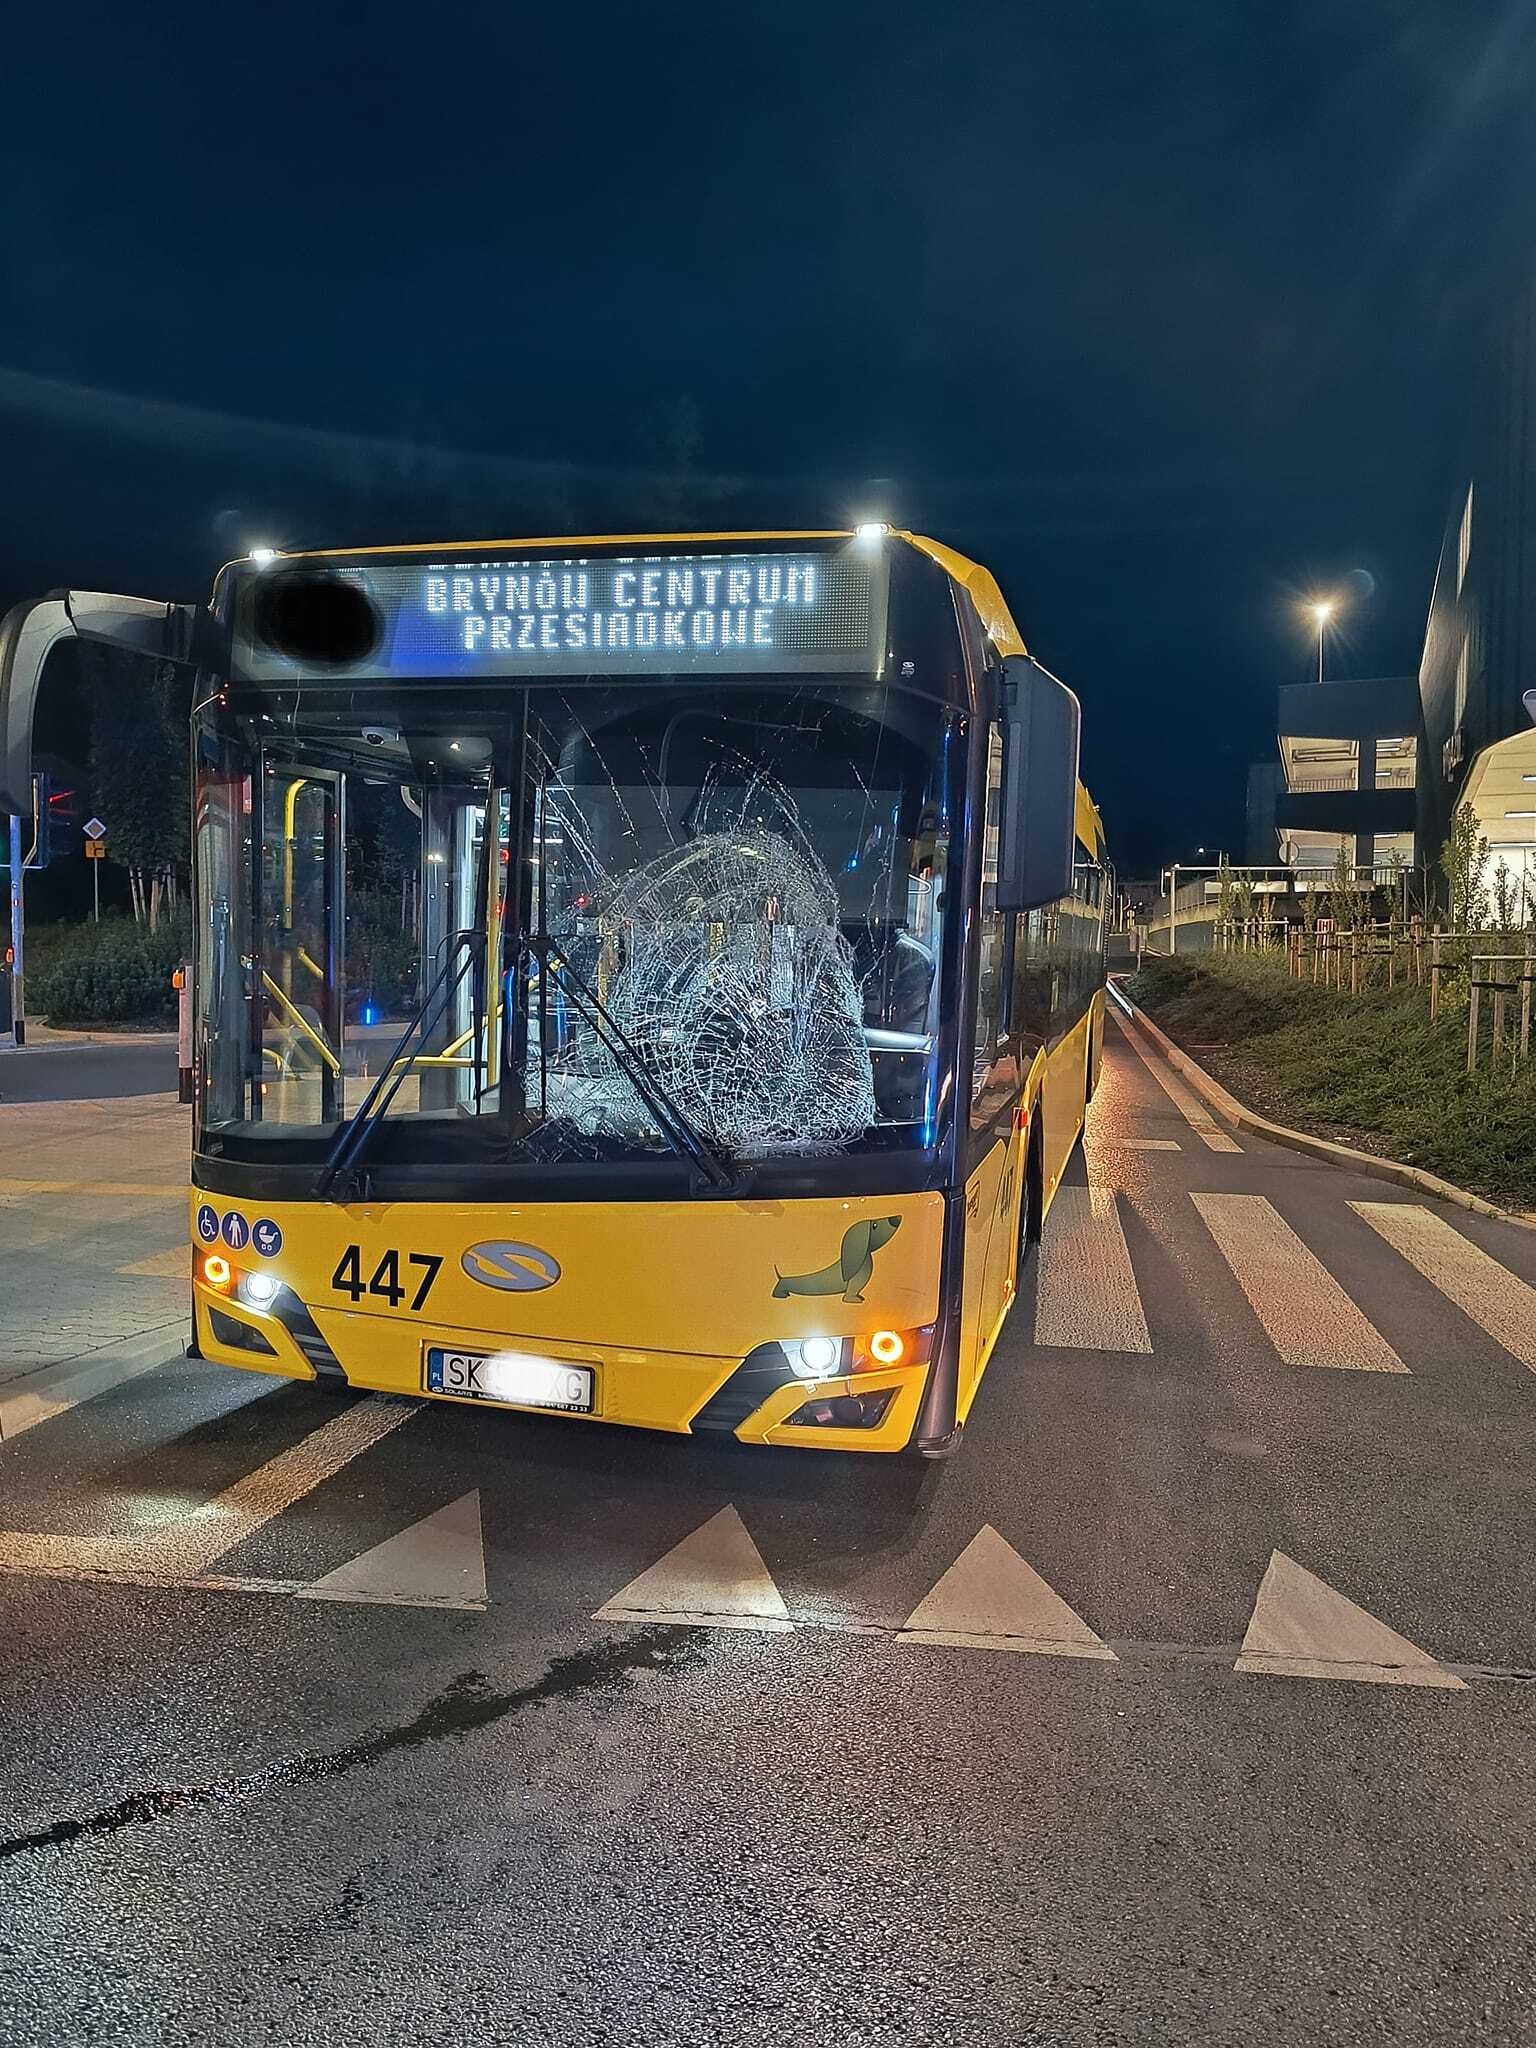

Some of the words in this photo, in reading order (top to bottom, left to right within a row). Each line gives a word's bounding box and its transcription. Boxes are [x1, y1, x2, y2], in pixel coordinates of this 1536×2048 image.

[613, 566, 816, 607] CENTRUM
[464, 609, 773, 649] PRZESIADKOWE
[331, 1243, 444, 1312] 447
[432, 1371, 442, 1381] PL
